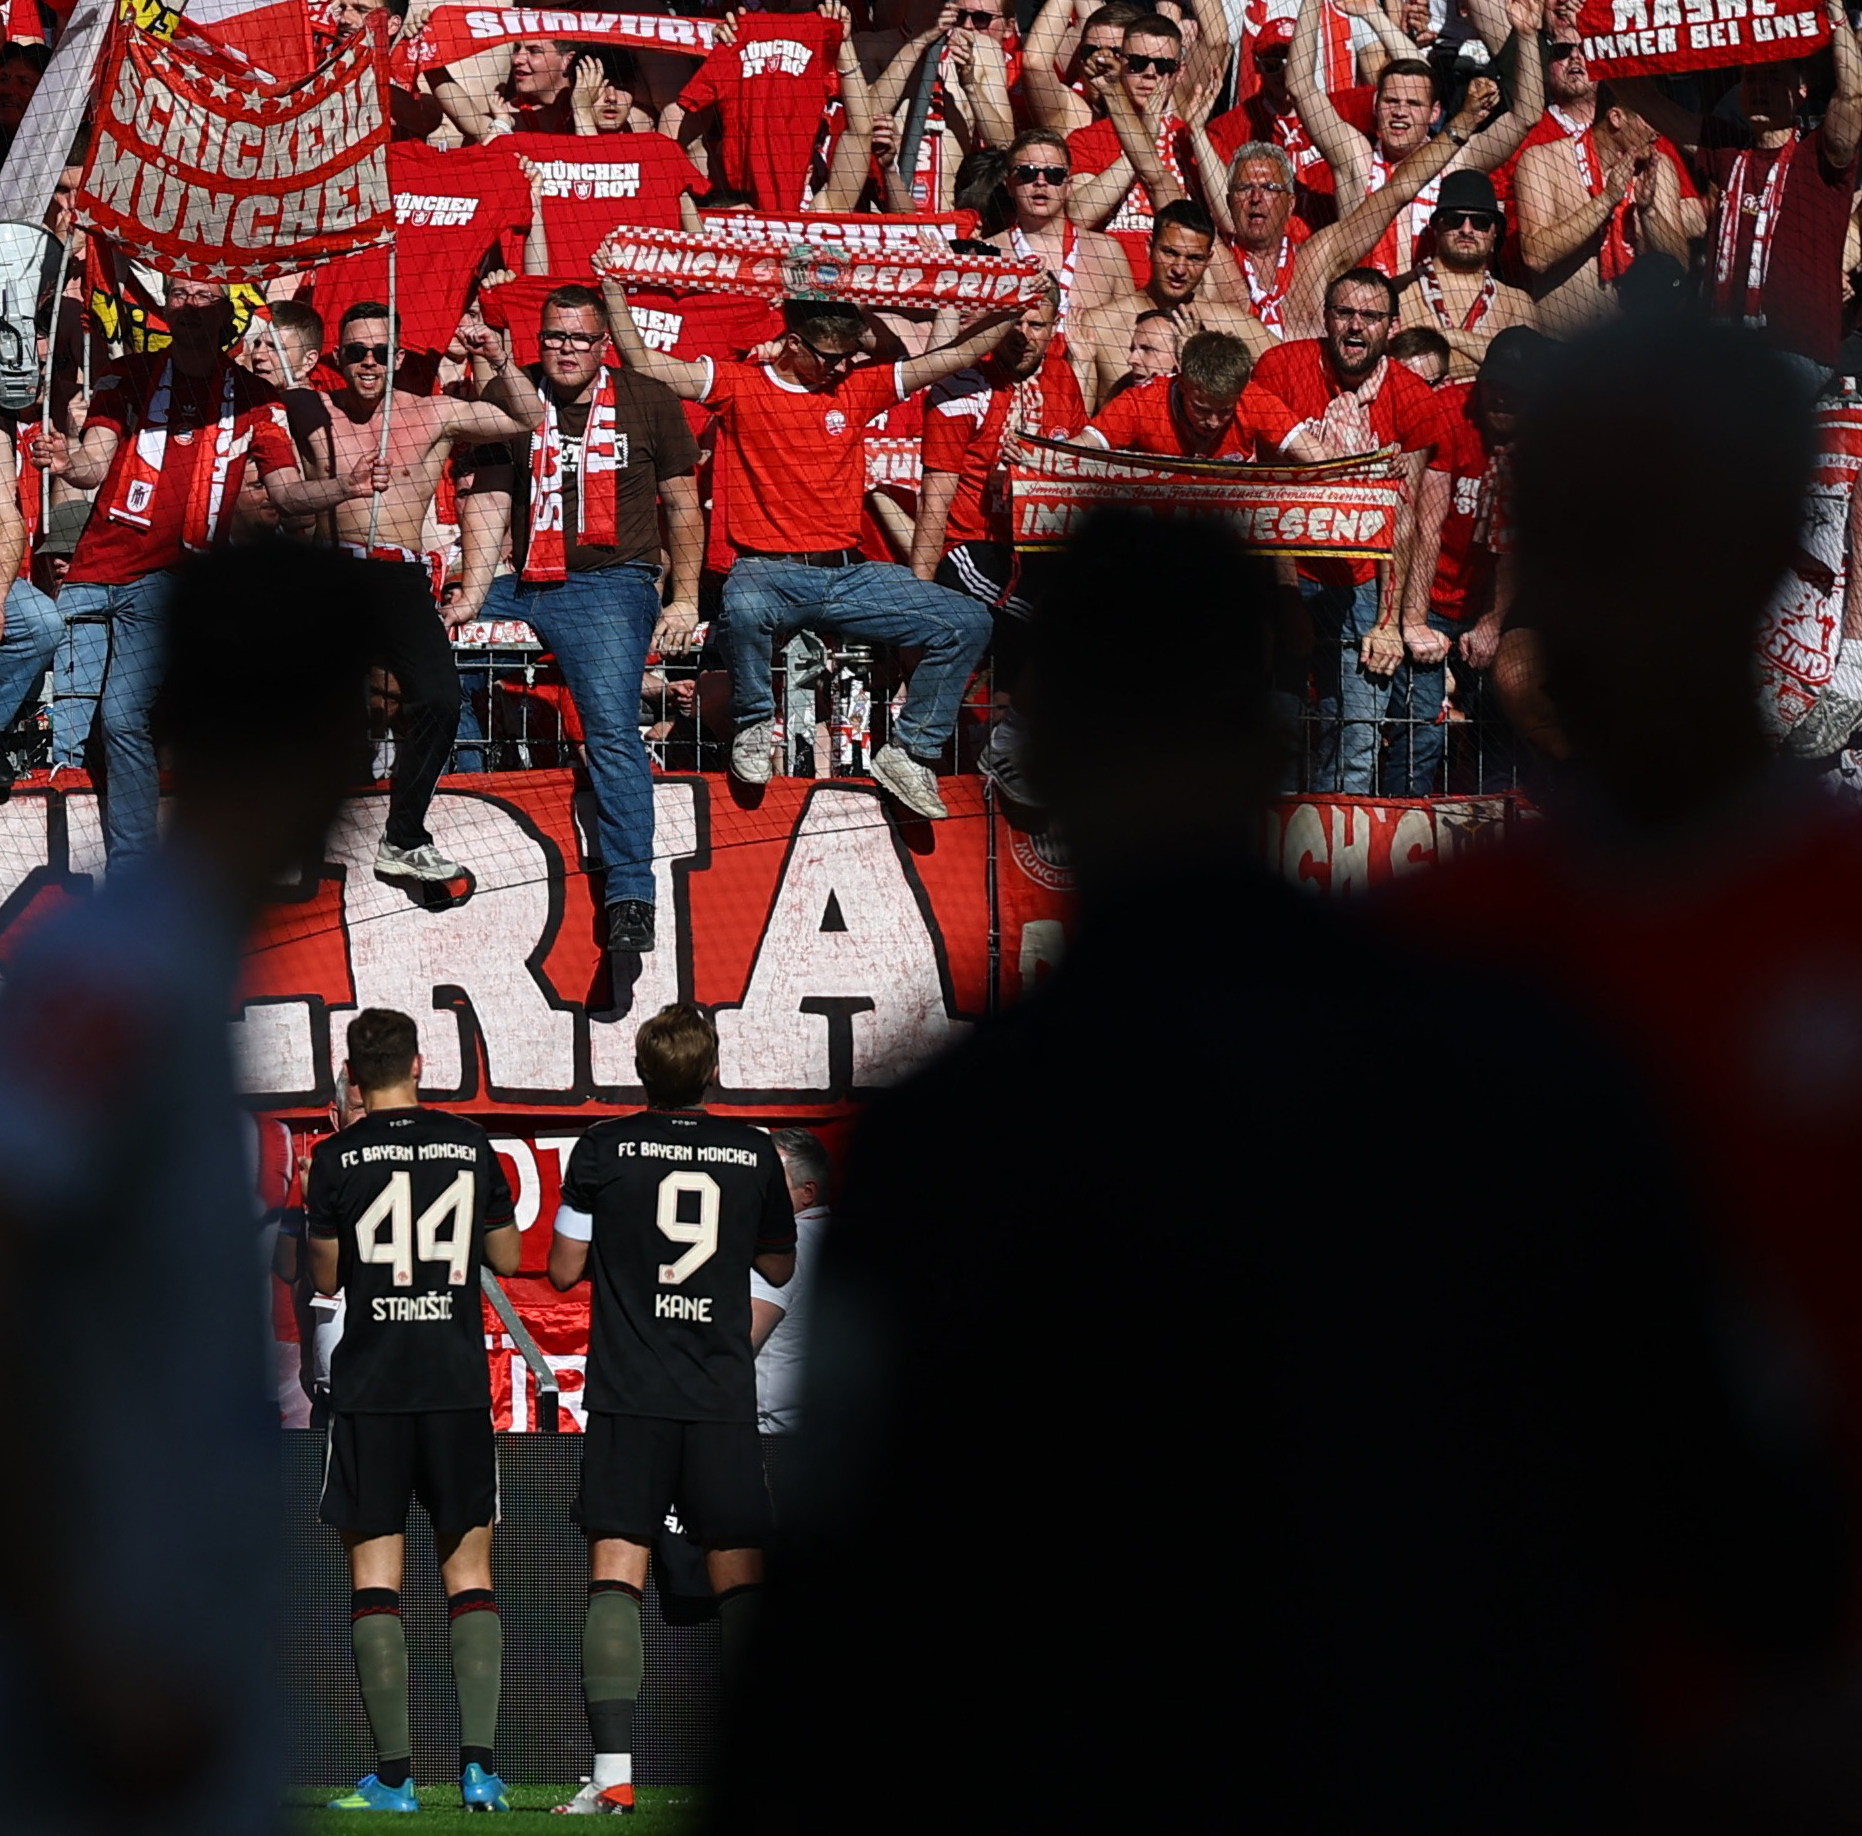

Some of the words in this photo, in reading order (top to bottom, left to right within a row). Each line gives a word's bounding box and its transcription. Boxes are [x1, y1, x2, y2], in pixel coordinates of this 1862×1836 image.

[1583, 26, 1679, 65] IMMER
[1689, 17, 1743, 51] BEI
[1752, 7, 1823, 46] UNS
[109, 64, 387, 172] SCHICKERIA
[82, 134, 390, 251] MÜNCHEN
[391, 193, 479, 214] ÜNCHEN
[594, 178, 642, 199] ROT
[428, 210, 477, 228] ROT
[340, 1149, 359, 1169] FC
[362, 1145, 414, 1167] BAYERN
[418, 1141, 477, 1162] MÜNCHEN
[618, 1140, 637, 1159] FC
[640, 1142, 693, 1162] BAYERN
[697, 1146, 758, 1167] MÜNCHEN
[354, 1170, 476, 1287] 44
[654, 1171, 721, 1286] 9
[370, 1289, 454, 1323] STANIŠIĆ
[654, 1293, 713, 1323] KANE
